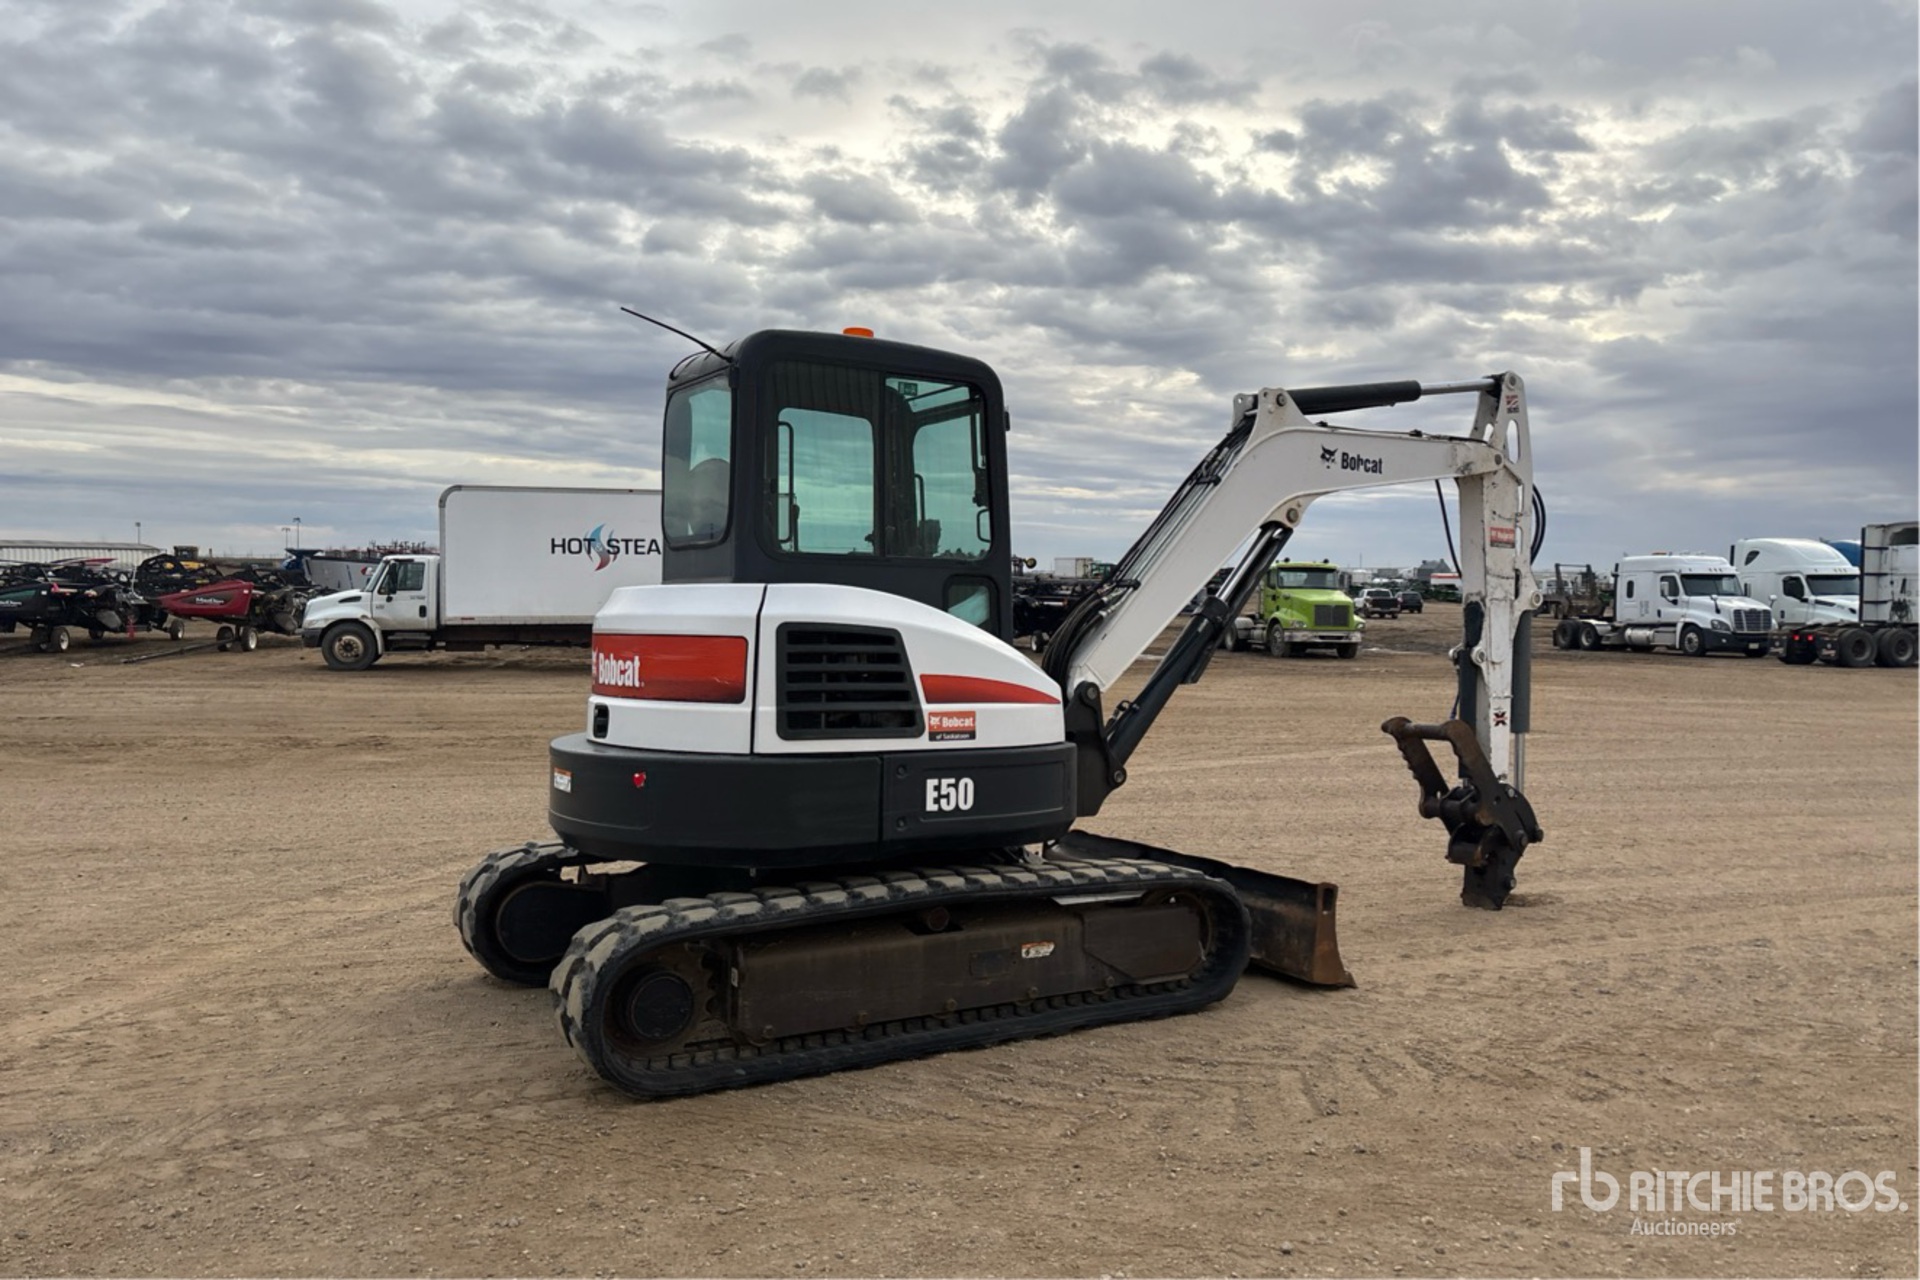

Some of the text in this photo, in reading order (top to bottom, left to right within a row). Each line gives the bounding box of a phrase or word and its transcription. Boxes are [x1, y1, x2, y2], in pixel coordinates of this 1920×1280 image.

[1341, 452, 1383, 475] Bobcat
[551, 538, 596, 555] HOT
[606, 538, 662, 555] STEA
[598, 652, 641, 688] Bobcat
[942, 716, 975, 728] Bobcat
[925, 777, 975, 812] E50
